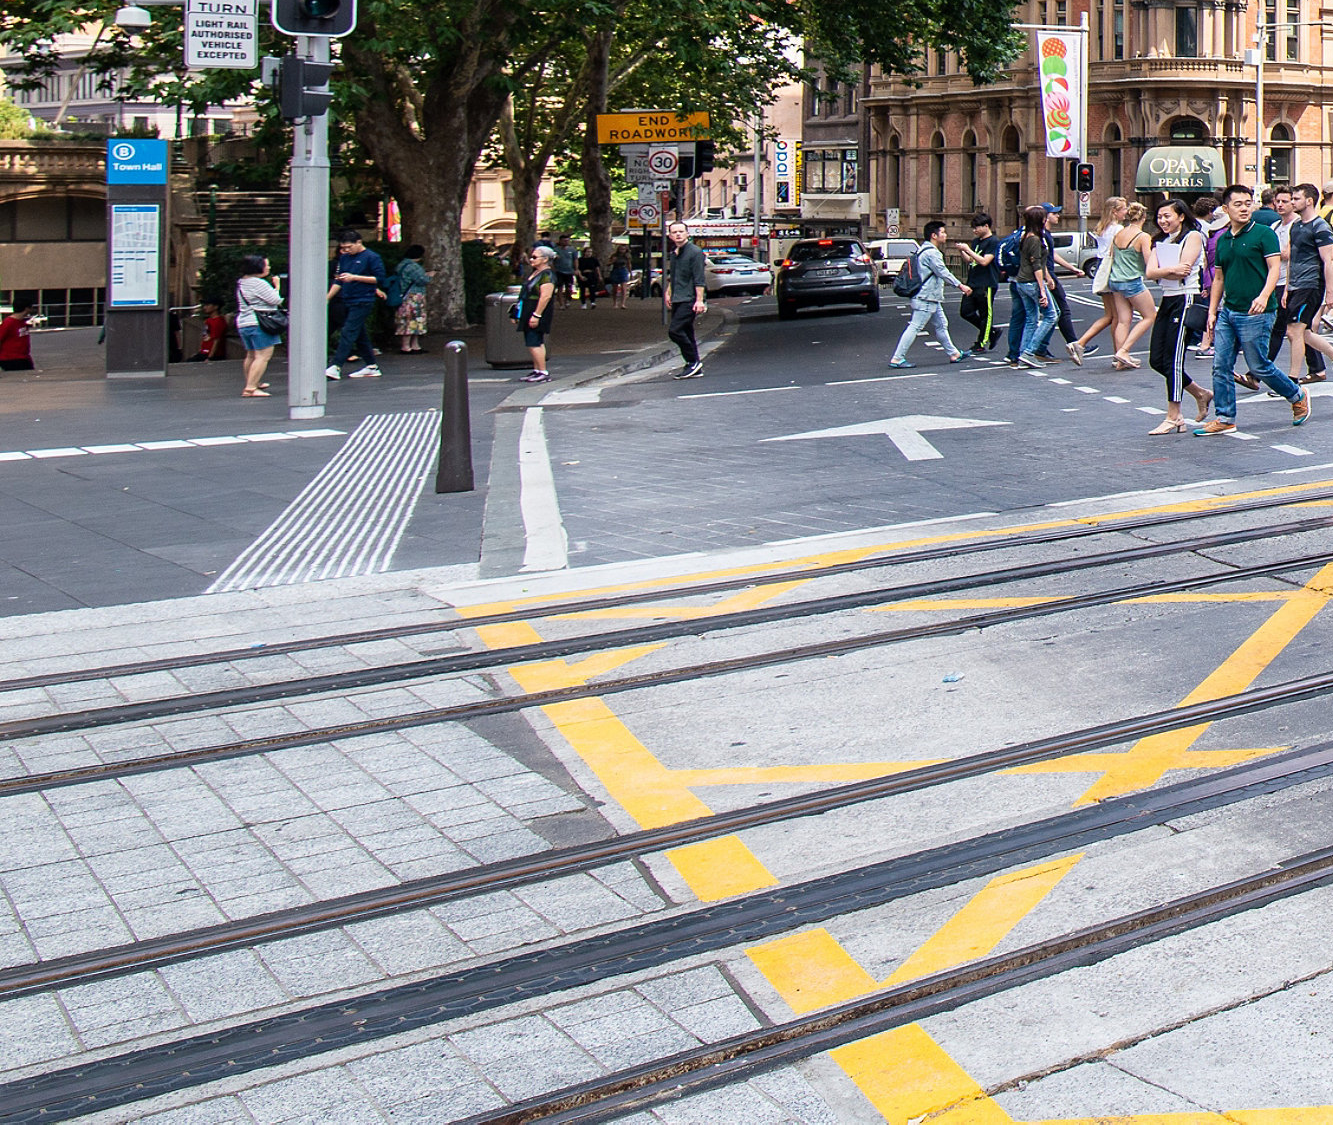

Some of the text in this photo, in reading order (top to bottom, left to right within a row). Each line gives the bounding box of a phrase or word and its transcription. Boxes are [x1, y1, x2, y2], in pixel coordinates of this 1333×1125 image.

[198, 2, 248, 15] TURN
[195, 19, 249, 29] LIGHT RAIL
[191, 30, 252, 40] AUTHORISED
[201, 40, 242, 50] VEHICLE
[197, 50, 247, 60] EXCEPTED
[638, 115, 670, 126] END
[654, 156, 673, 168] 30
[776, 140, 789, 177] opal
[112, 162, 163, 171] Town Hall
[1149, 157, 1214, 175] OPALS
[1158, 177, 1204, 187] PEARLS
[642, 208, 654, 218] 30
